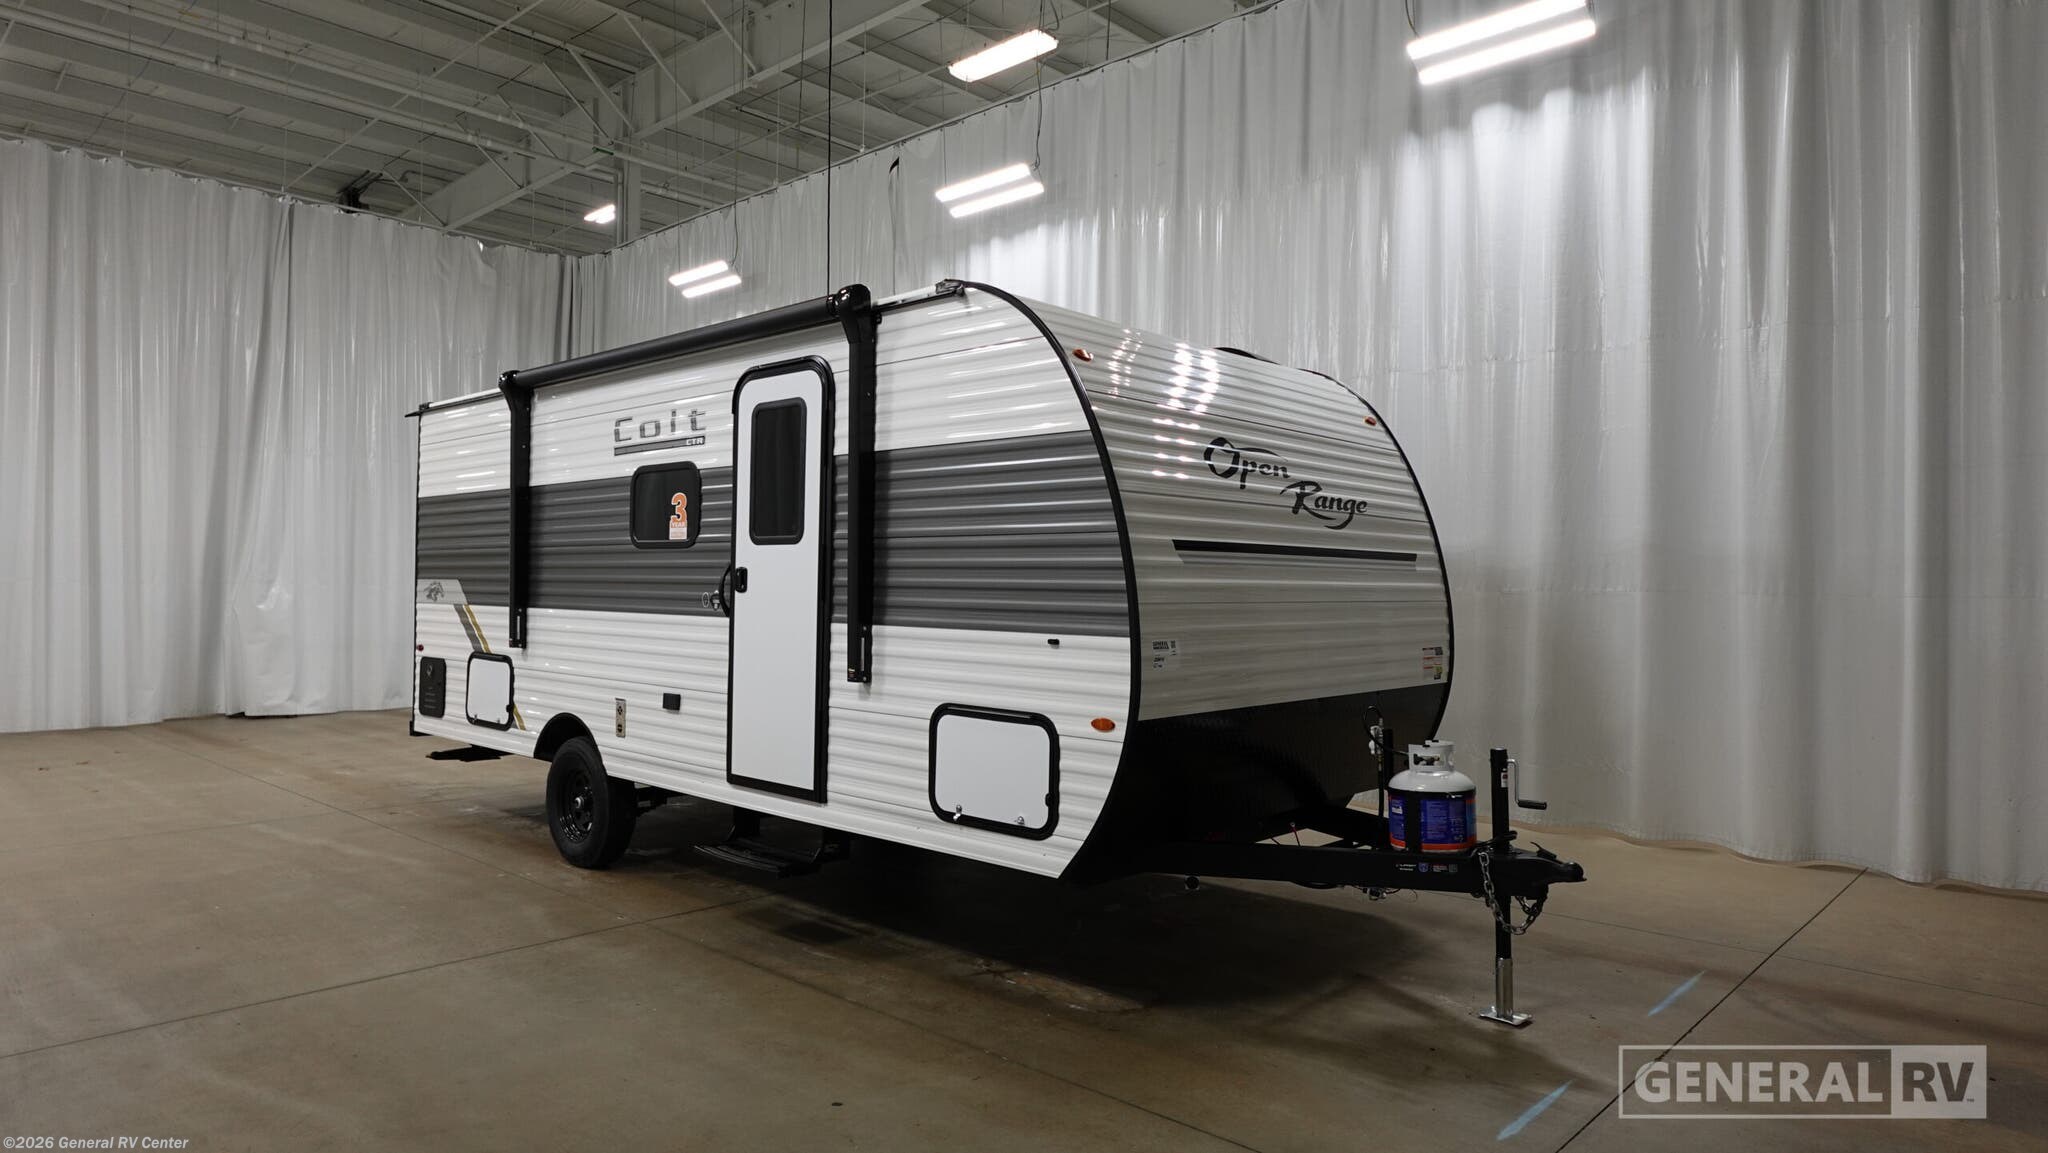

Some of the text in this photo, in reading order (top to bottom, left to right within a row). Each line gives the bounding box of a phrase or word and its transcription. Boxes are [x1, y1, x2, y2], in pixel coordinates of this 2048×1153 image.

[1204, 437, 1290, 490] Open
[670, 492, 688, 523] 3
[1280, 480, 1368, 530] Range
